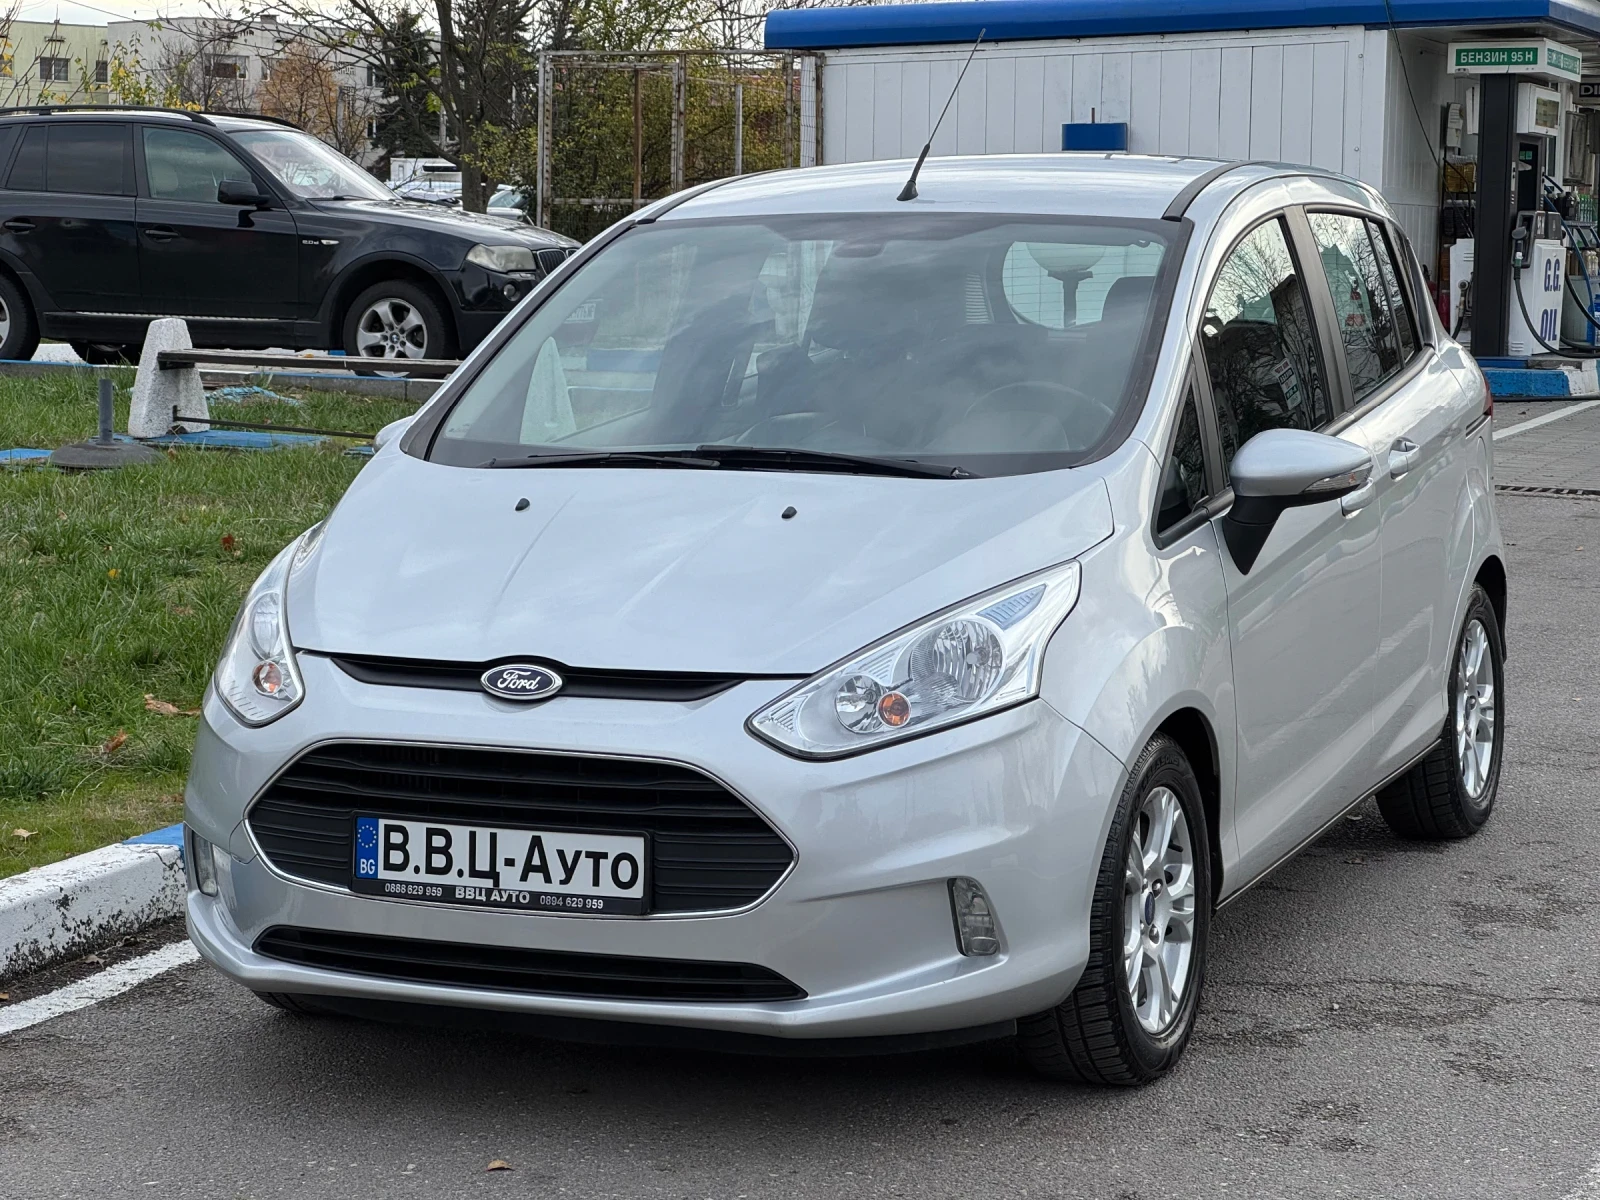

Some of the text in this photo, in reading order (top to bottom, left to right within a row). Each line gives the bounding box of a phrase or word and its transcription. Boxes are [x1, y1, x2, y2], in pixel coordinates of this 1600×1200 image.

[1460, 51, 1508, 63] БЕНЗИН
[1540, 308, 1558, 342] OIL
[497, 669, 542, 690] Ford
[360, 858, 376, 875] BG
[407, 884, 424, 895] 629
[425, 885, 443, 897] 959
[455, 886, 530, 904] ВВЦ АУТО
[539, 895, 604, 909] 0894 629 959
